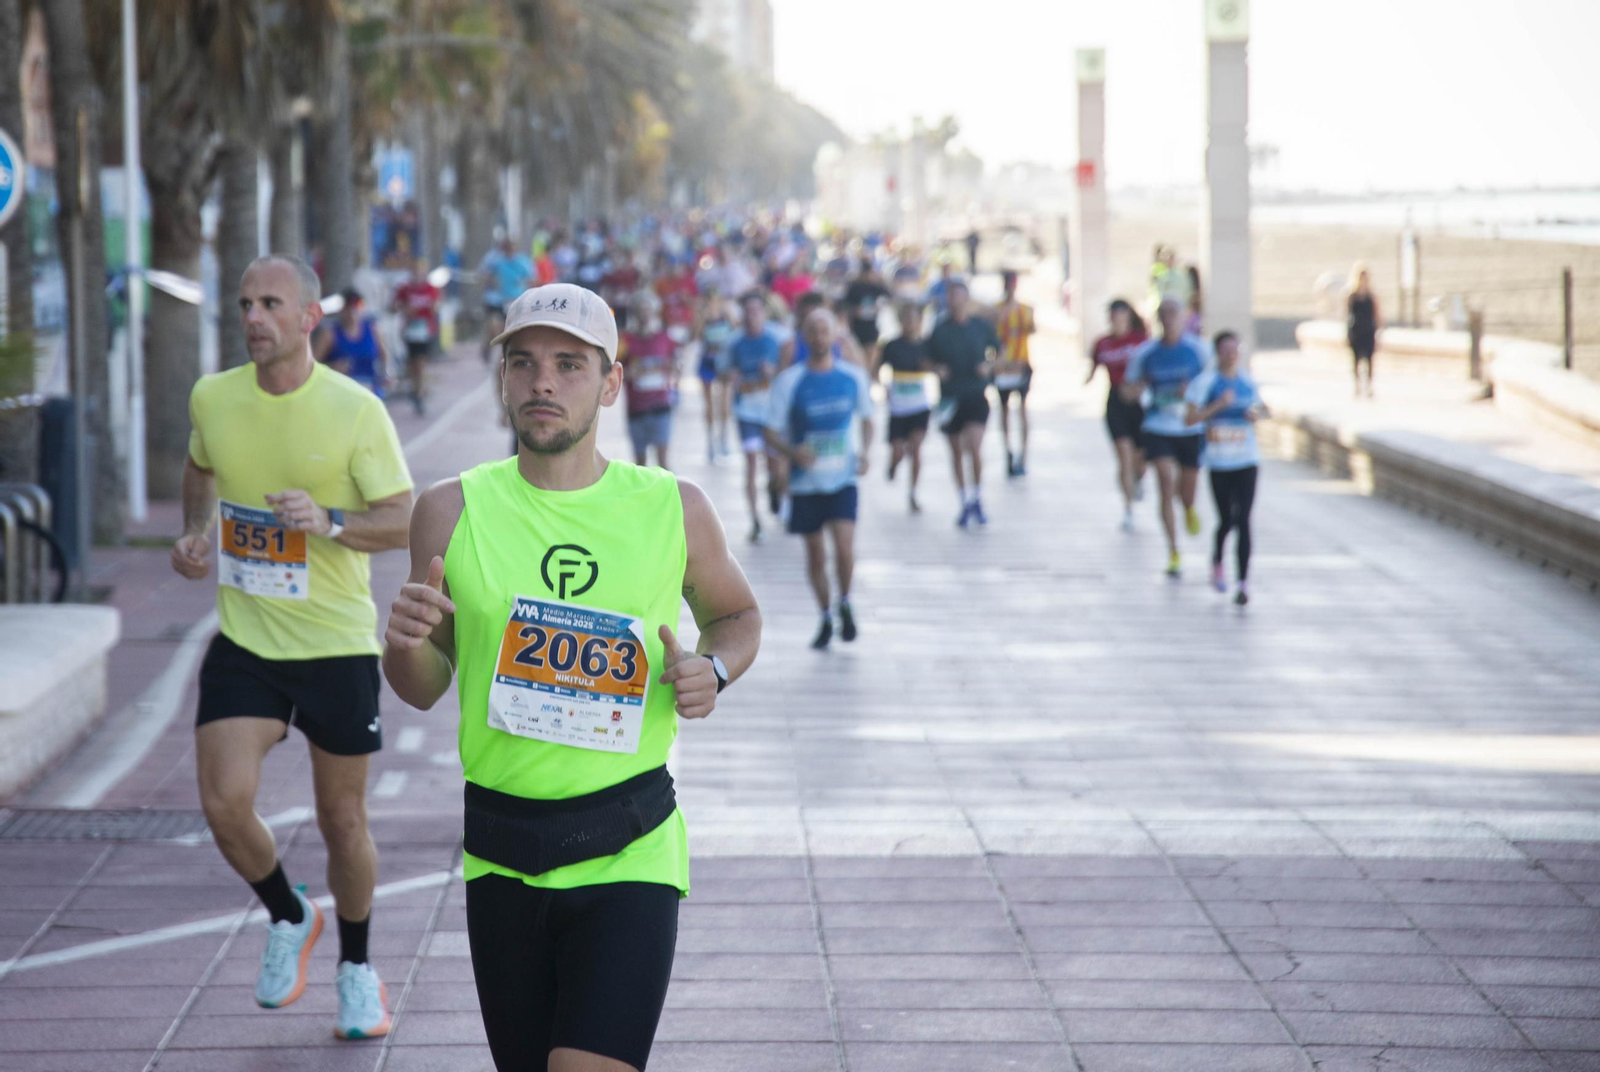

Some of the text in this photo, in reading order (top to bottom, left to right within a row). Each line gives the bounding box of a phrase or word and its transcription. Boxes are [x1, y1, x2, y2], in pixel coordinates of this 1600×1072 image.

[233, 522, 284, 553] 551
[566, 610, 595, 621] Maratón
[572, 618, 594, 629] 2025
[513, 624, 638, 682] 2063
[555, 672, 596, 687] NIKITULA
